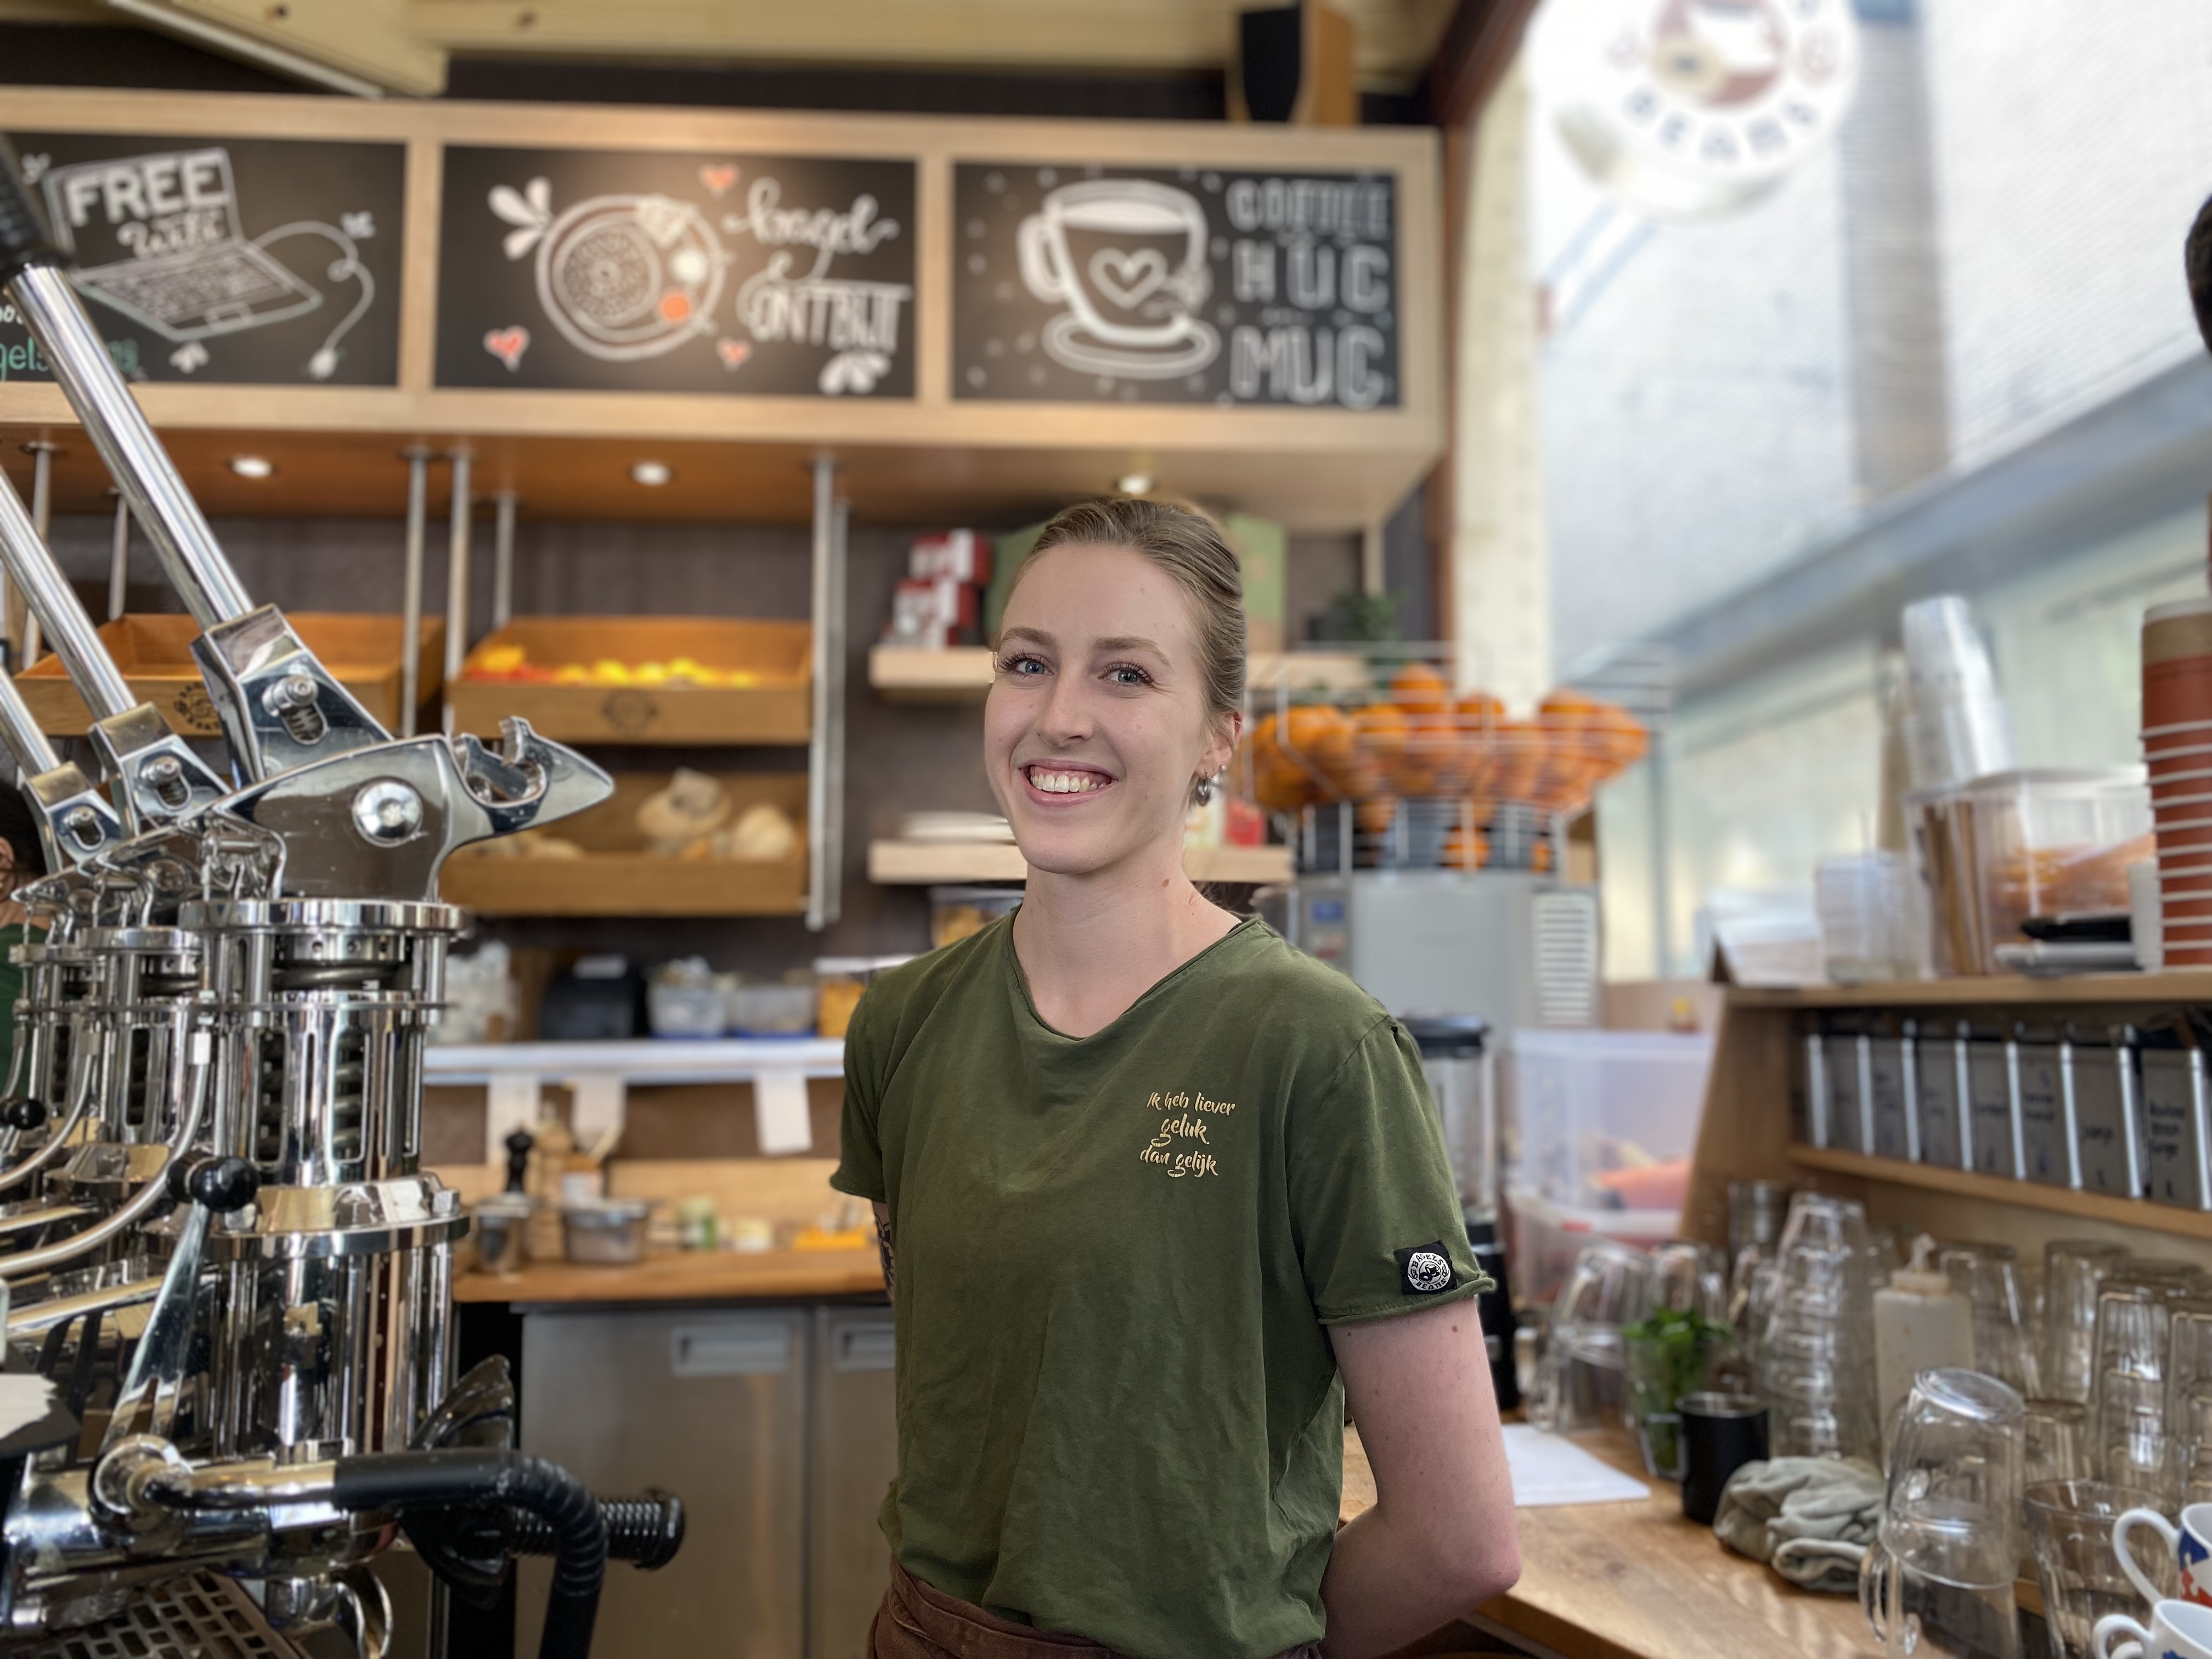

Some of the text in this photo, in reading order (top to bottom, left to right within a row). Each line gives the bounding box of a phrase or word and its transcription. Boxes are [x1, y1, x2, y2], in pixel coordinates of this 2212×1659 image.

[64, 153, 231, 227] FREE
[1226, 177, 1389, 240] COFFEE
[1147, 1092, 1235, 1116] Ik heb liever
[1151, 1113, 1210, 1147] geluk
[1140, 1144, 1218, 1177] dan gelijk
[1412, 1254, 1443, 1268] BAGELS
[1415, 1279, 1446, 1289] BEANS
